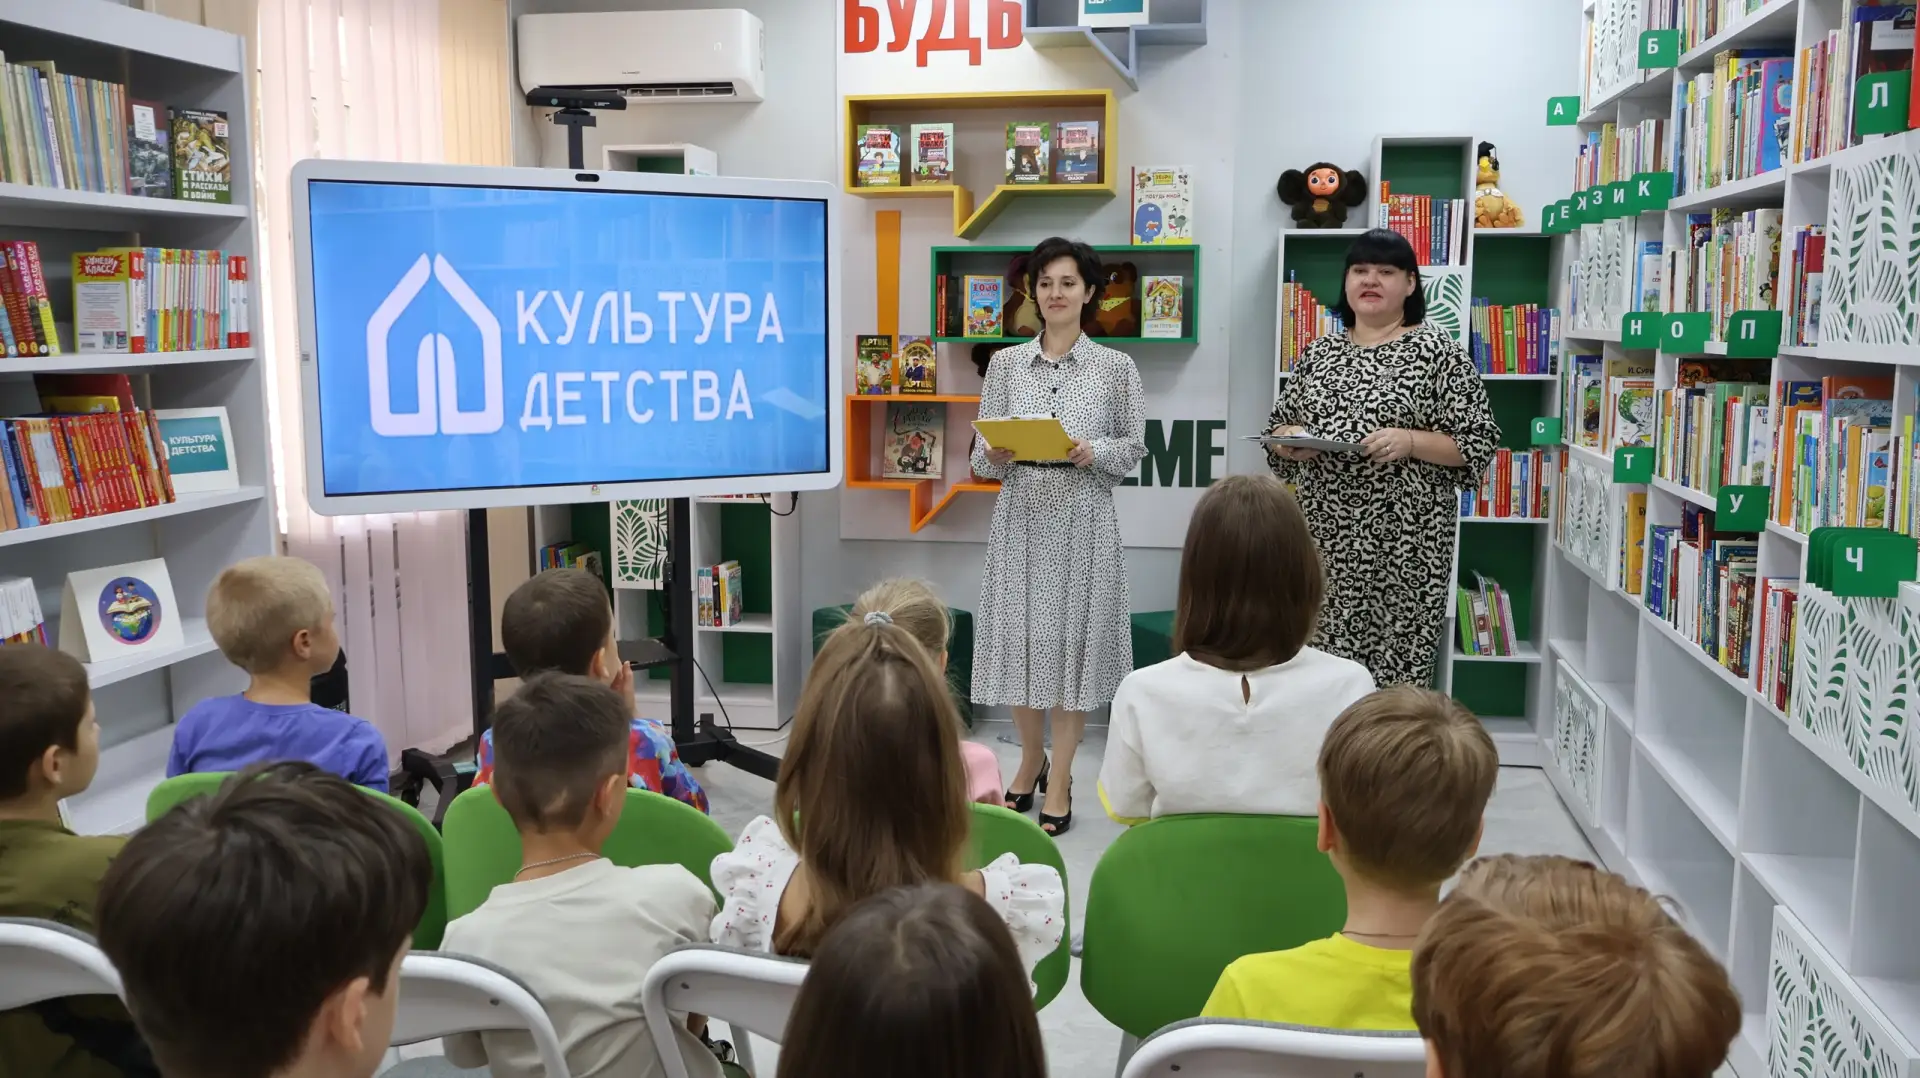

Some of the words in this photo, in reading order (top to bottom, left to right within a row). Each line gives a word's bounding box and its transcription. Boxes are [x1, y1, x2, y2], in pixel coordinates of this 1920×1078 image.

[1647, 38, 1659, 54] Б
[1868, 81, 1888, 109] Л
[1553, 102, 1564, 116] А
[182, 170, 222, 183] СТИХИ
[183, 190, 189, 198] О
[190, 189, 216, 200] ВОЙНЕ
[190, 182, 229, 191] РАССКАЗЫ
[1638, 180, 1650, 196] К
[1592, 190, 1602, 205] З
[1613, 188, 1625, 204] И
[1560, 205, 1569, 219] Е
[517, 290, 785, 346] КУЛЬТУРА
[1630, 319, 1642, 336] Н
[1671, 321, 1684, 338] О
[1740, 319, 1756, 340] П
[861, 338, 888, 346] АРТЕК
[519, 368, 753, 432] ДЕТСТВА
[1536, 421, 1545, 434] С
[169, 434, 217, 445] КУЛЬТУРА
[171, 444, 216, 456] ДЕТСТВА
[1119, 419, 1227, 488] МЕ
[1623, 453, 1635, 470] Т
[1729, 493, 1744, 513] У
[1845, 547, 1863, 572] Ч
